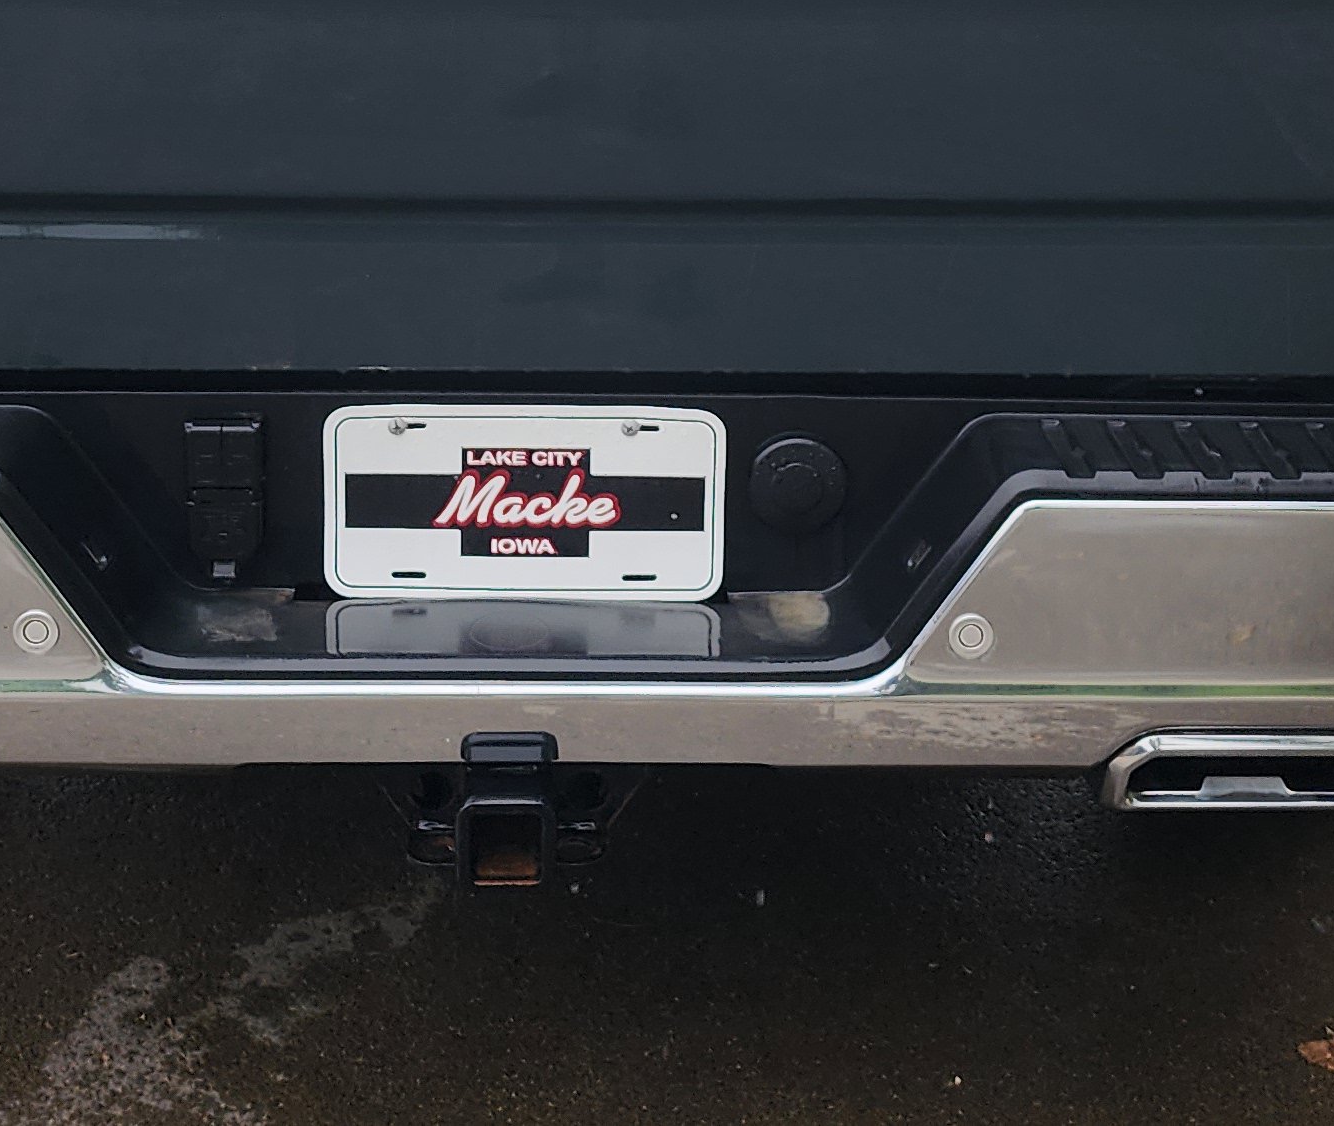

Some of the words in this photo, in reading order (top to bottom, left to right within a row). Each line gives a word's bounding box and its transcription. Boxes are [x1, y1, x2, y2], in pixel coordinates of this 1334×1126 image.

[467, 451, 527, 466] LAKE
[532, 451, 583, 467] CITY
[433, 469, 619, 527] Macke
[490, 538, 556, 555] IOWA
